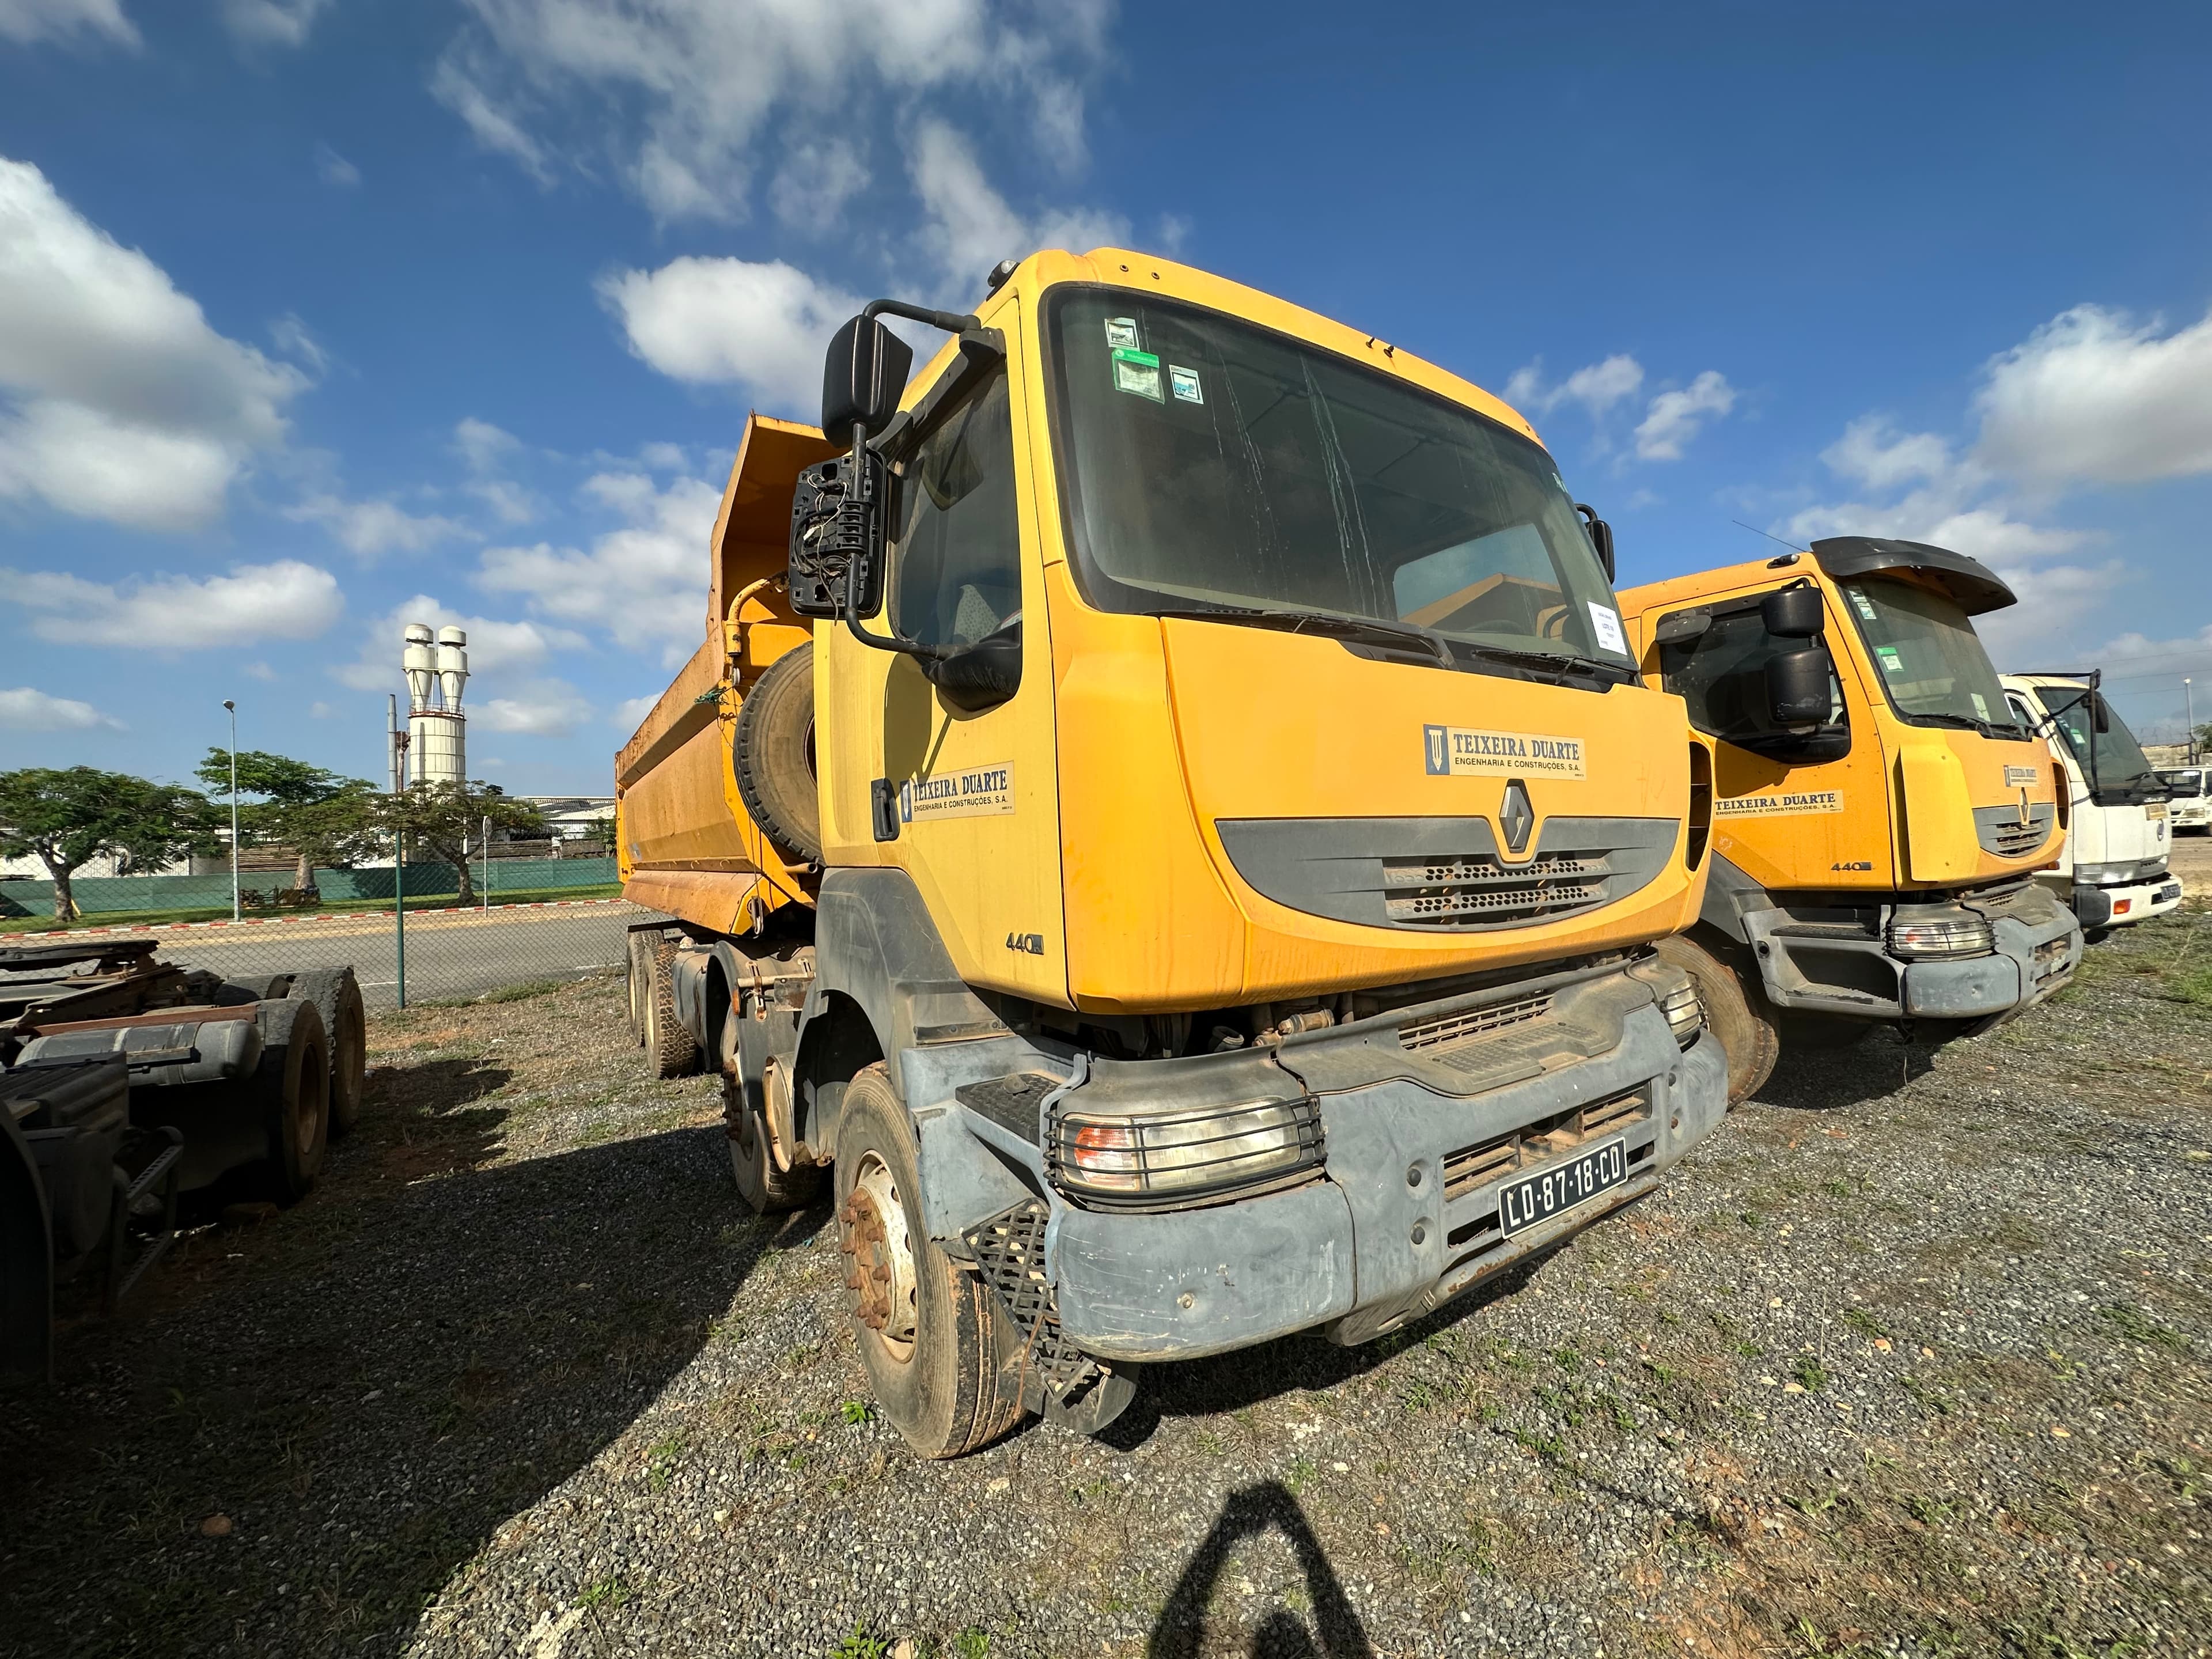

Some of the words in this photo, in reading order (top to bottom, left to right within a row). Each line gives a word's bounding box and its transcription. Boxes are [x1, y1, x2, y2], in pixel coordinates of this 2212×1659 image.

[1453, 733, 1527, 757] TEIXEIRA
[1531, 740, 1580, 761] DUARTE
[1455, 757, 1505, 767] ENGENHARIA
[1514, 760, 1567, 771] CONSTRUÇÕES,
[912, 778, 958, 803] TEIXEIRA
[962, 770, 1007, 795] DUARTE
[914, 803, 943, 812] ENGENHARIA
[949, 796, 993, 808] CONSTRUÇÕES,
[995, 795, 1008, 803] S.A.
[1715, 798, 1778, 810] TEIXEIRA
[1782, 793, 1836, 806] DUARTE
[1831, 862, 1861, 871] 440
[1006, 932, 1033, 953] 440
